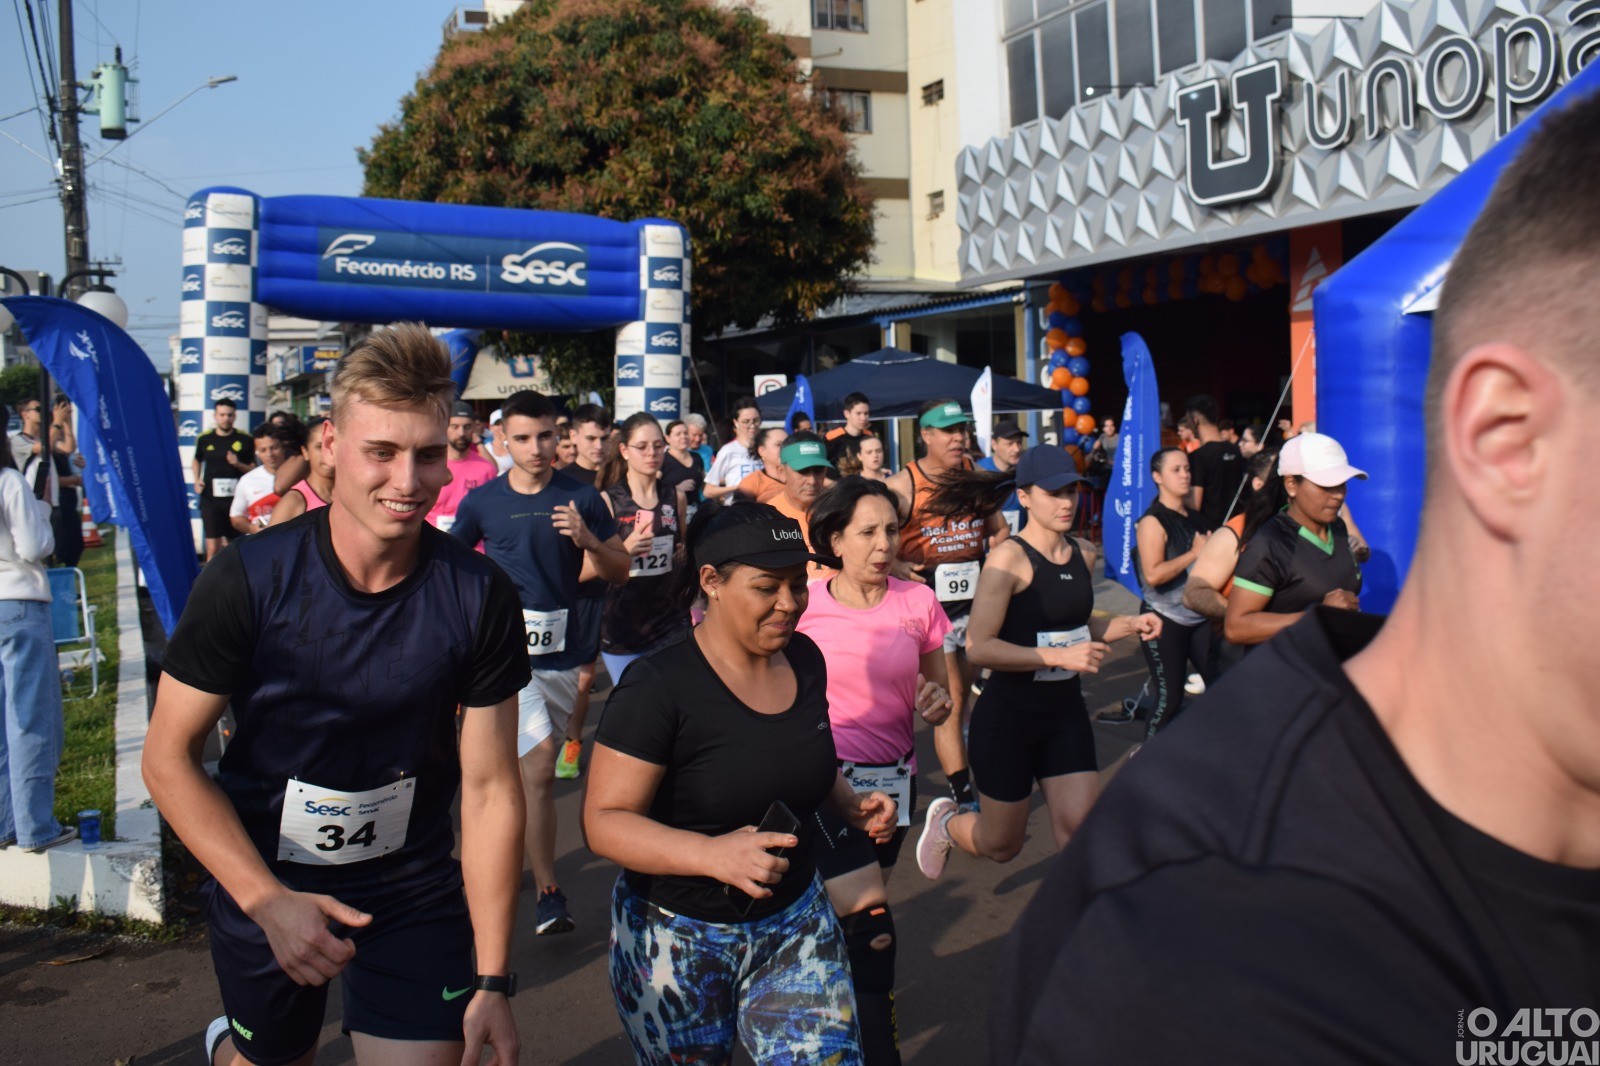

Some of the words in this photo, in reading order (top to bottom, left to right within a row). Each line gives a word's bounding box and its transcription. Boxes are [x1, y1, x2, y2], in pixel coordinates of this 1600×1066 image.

[213, 240, 247, 255] Sesc
[335, 257, 446, 280] Fecomércio
[451, 263, 477, 281] RS
[501, 246, 586, 287] Sesc
[653, 268, 680, 281] Sesc
[211, 313, 246, 328] Sesc
[651, 333, 679, 347] Sesc
[650, 399, 677, 412] Sesc
[634, 554, 667, 570] 122
[949, 579, 969, 594] 99
[852, 777, 879, 788] Sesc
[304, 799, 352, 816] Sesc
[315, 820, 377, 852] 34
